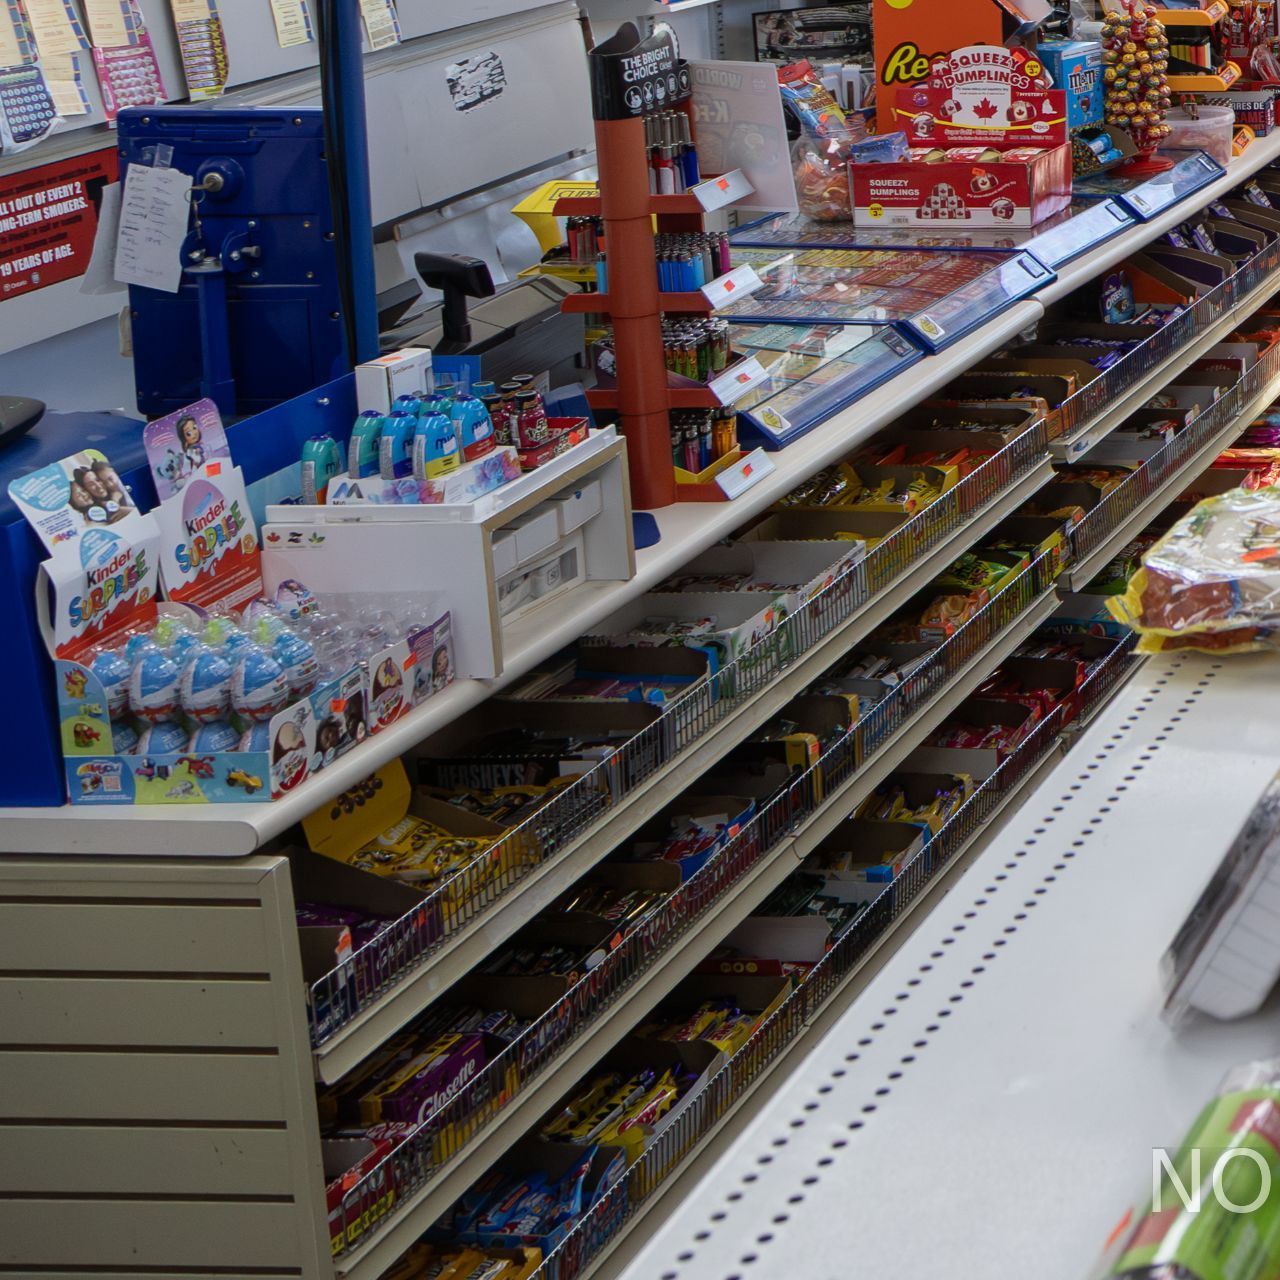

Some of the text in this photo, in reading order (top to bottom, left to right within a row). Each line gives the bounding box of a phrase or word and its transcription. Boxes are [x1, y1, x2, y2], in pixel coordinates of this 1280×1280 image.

[621, 45, 670, 71] THE BRIGHT
[948, 51, 1021, 71] SQUEEZY
[623, 63, 659, 83] CHOICE
[943, 69, 1030, 90] DUMPLINGS
[869, 179, 909, 187] SQUEEZY
[869, 188, 920, 197] DUMPLINGS
[16, 194, 34, 211] OUT
[35, 192, 47, 206] OF
[47, 185, 75, 203] EVERY
[73, 181, 82, 194] 2
[43, 196, 88, 221] SMOKERS.
[0, 262, 12, 277] 19
[12, 253, 43, 273] YEARS
[42, 249, 54, 263] OF
[55, 243, 75, 260] AGE.
[1105, 289, 1124, 311] OREO
[185, 498, 227, 537] Kinder
[174, 500, 248, 574] SURPRISE
[86, 547, 132, 589] Kinder
[68, 549, 149, 628] SURPRISE
